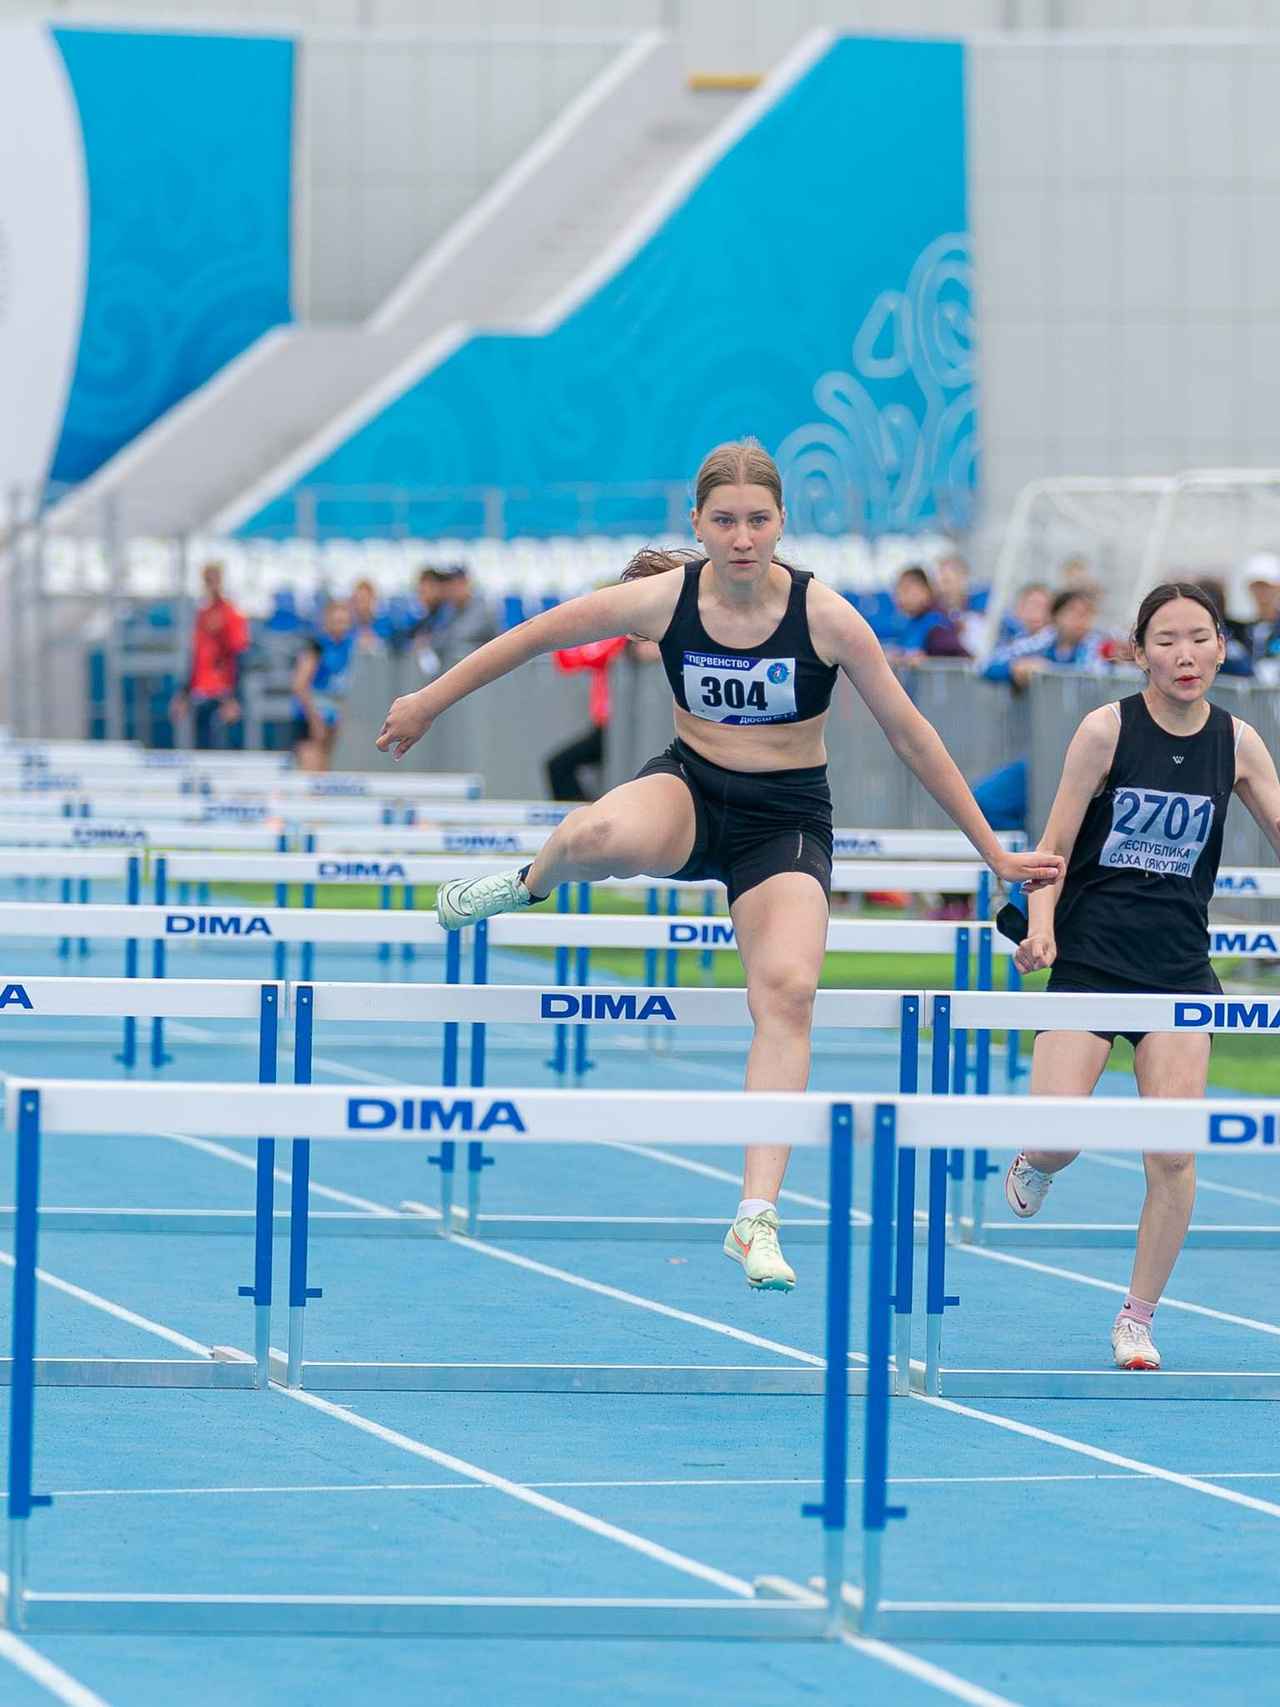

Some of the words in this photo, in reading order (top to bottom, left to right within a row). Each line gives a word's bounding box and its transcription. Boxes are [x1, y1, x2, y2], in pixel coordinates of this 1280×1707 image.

[700, 676, 769, 711] 304
[1113, 791, 1212, 843] 2701
[318, 862, 407, 878] DIMA
[1109, 853, 1142, 867] САХА
[1144, 857, 1191, 876] (ЯКУТИЯ)
[165, 915, 272, 936] DIMA
[669, 924, 734, 942] DIM
[1211, 933, 1278, 952] MA
[541, 994, 676, 1021] DIMA
[347, 1098, 526, 1133] DIMA
